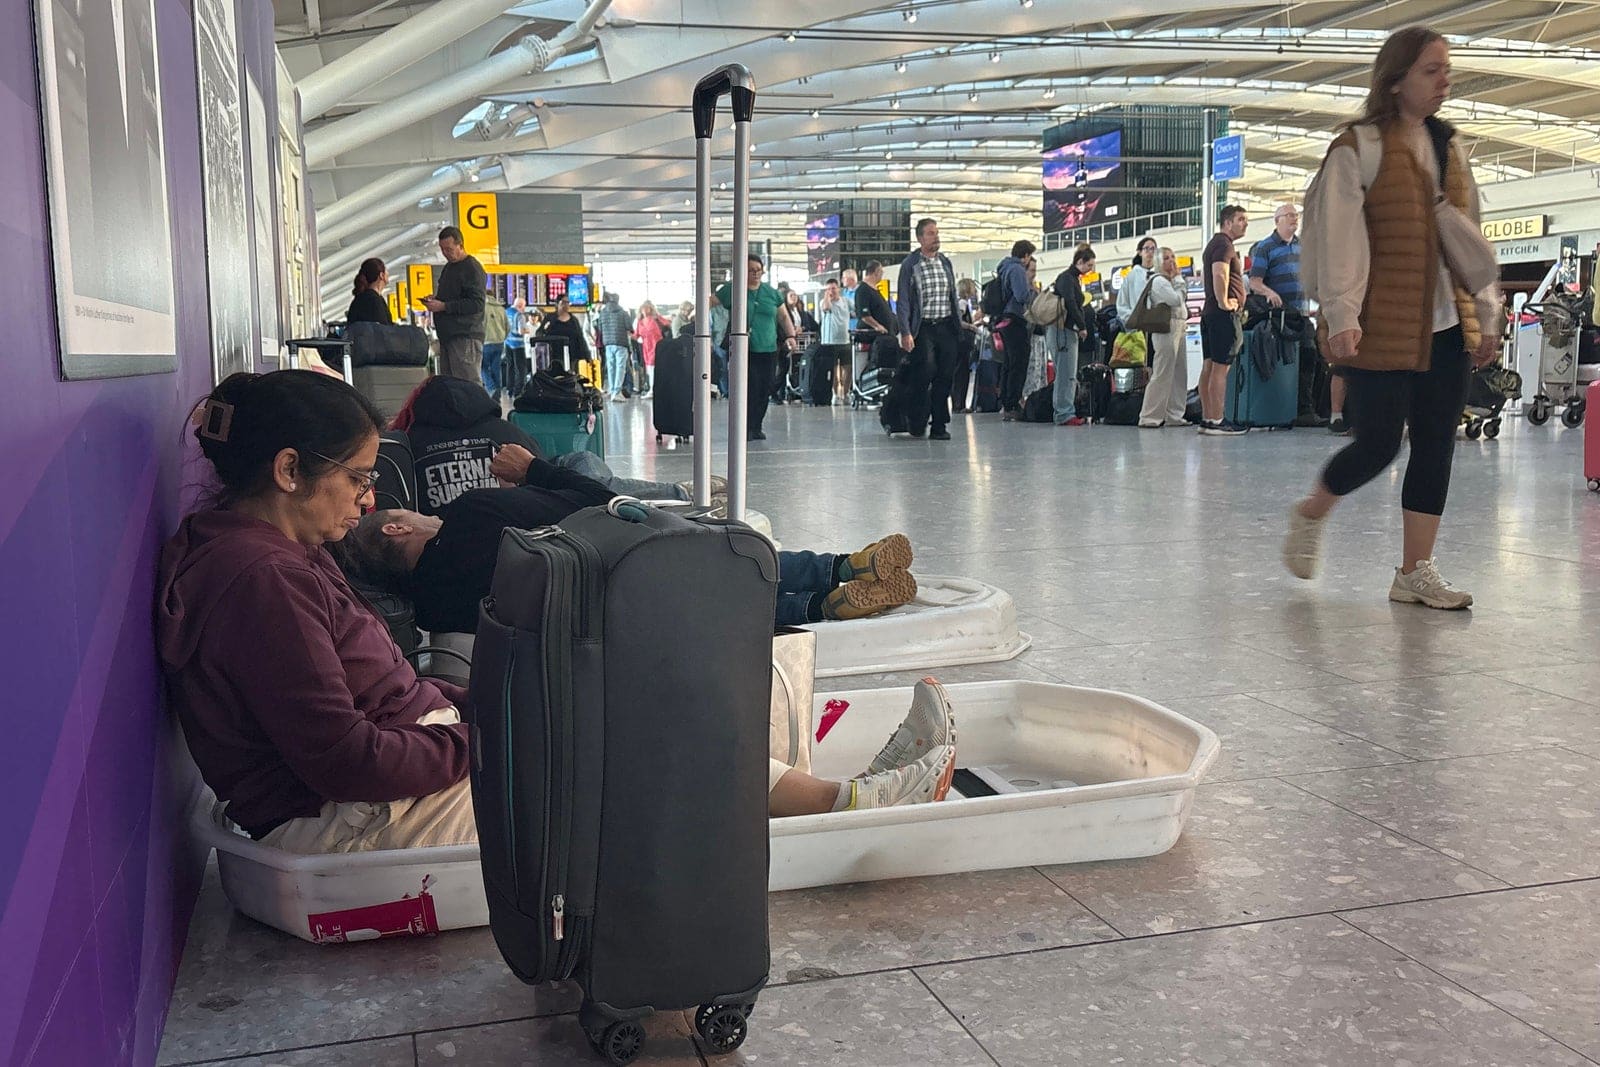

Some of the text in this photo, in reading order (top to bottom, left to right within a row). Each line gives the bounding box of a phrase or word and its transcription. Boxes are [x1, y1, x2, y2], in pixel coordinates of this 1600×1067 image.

[467, 204, 488, 230] G
[1484, 220, 1534, 239] GLOBE
[1500, 244, 1539, 256] KITCHEN
[416, 271, 426, 286] F
[453, 451, 473, 461] THE
[425, 457, 497, 488] ETERNA
